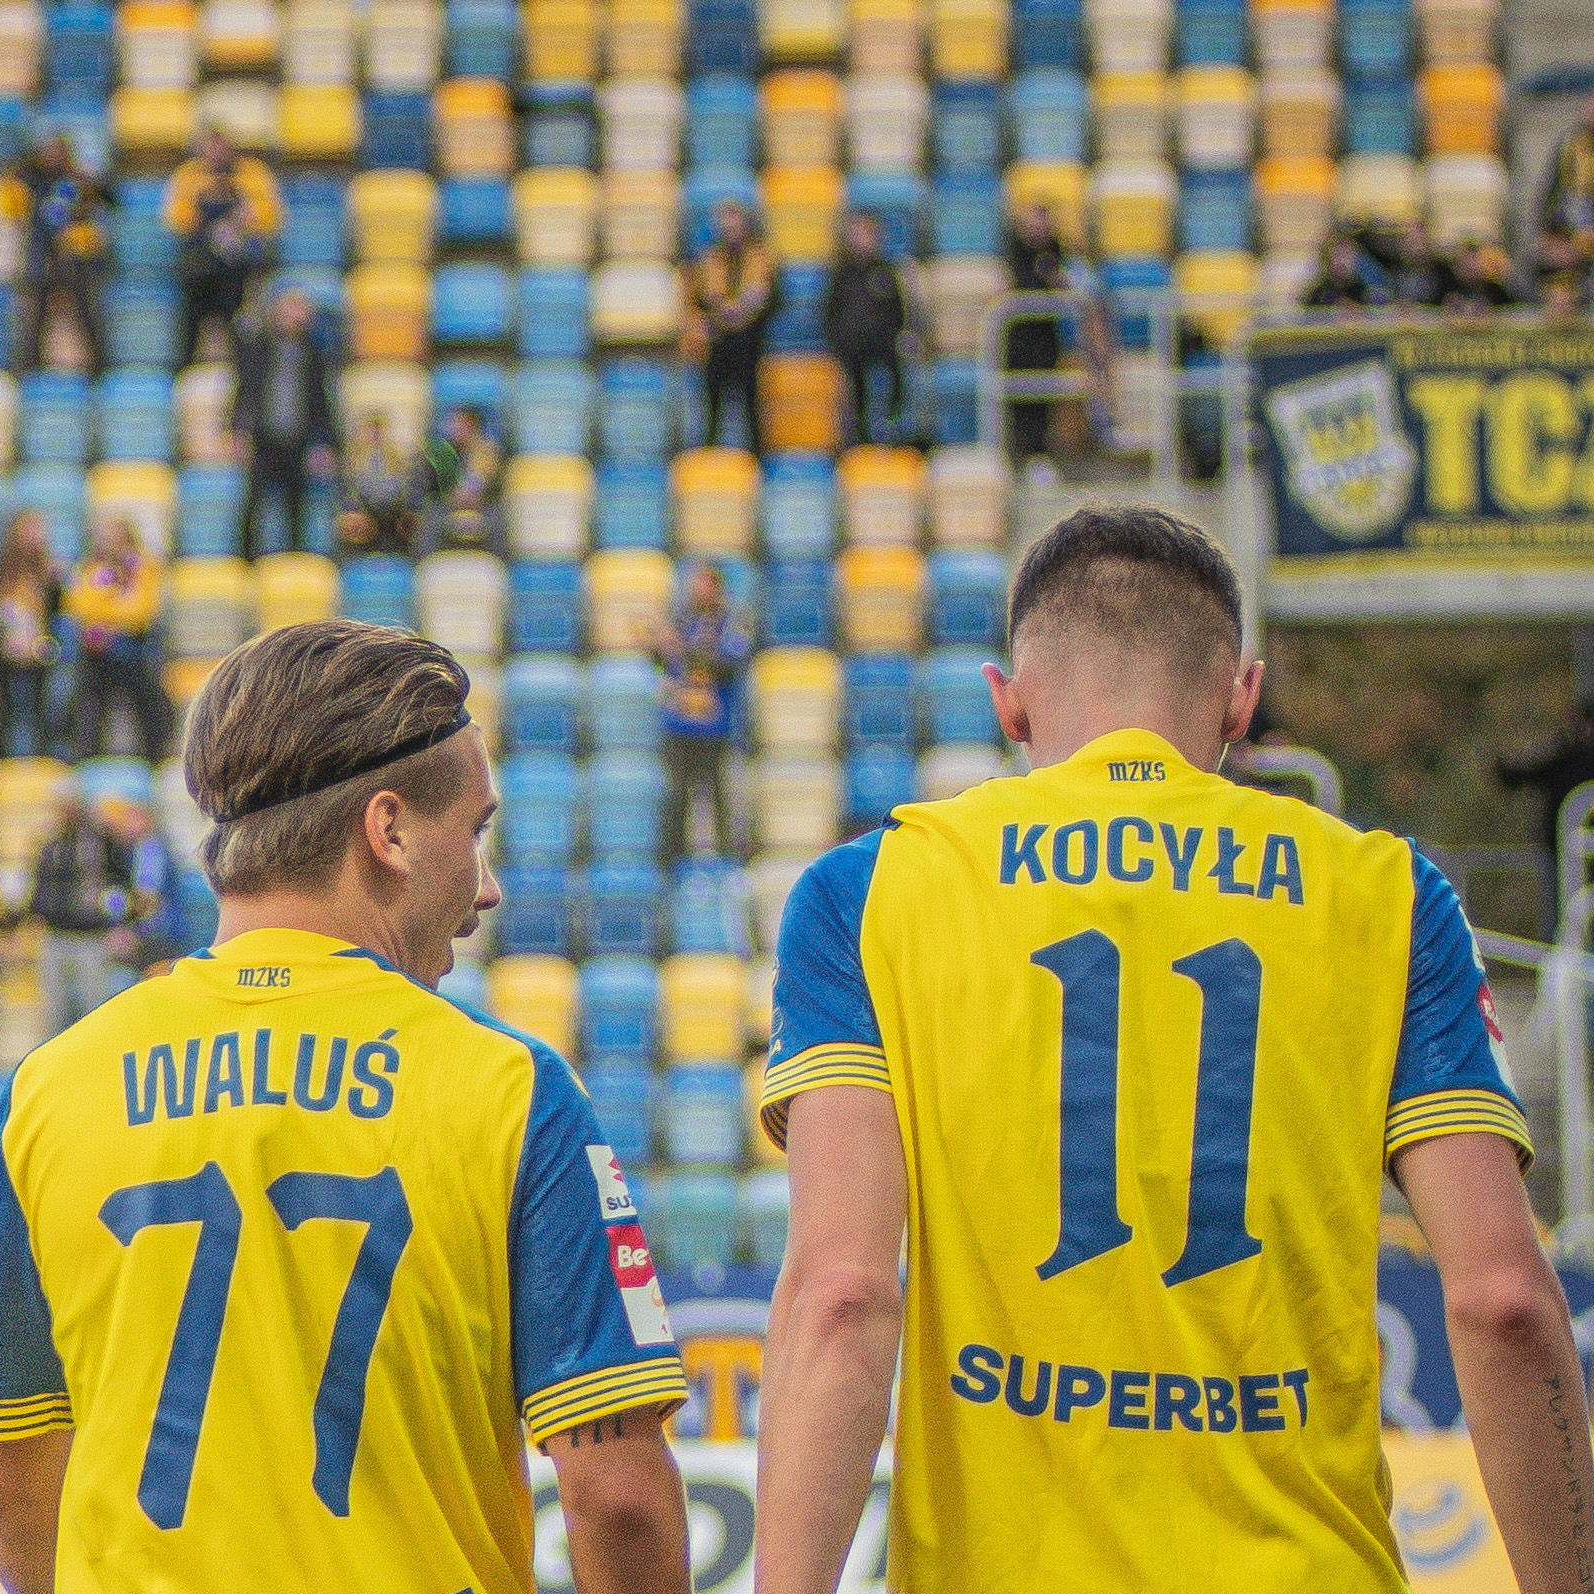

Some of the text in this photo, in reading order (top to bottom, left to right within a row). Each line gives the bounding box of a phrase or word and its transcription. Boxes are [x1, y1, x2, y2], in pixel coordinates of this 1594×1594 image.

[1108, 760, 1167, 783] MZKS
[999, 815, 1306, 906] KOCYŁA
[237, 965, 292, 989] MZKS
[122, 1028, 400, 1127] WALUŚ
[1029, 928, 1264, 1288] 11
[97, 1160, 414, 1531] 77
[950, 1344, 1310, 1434] SUPERBET
